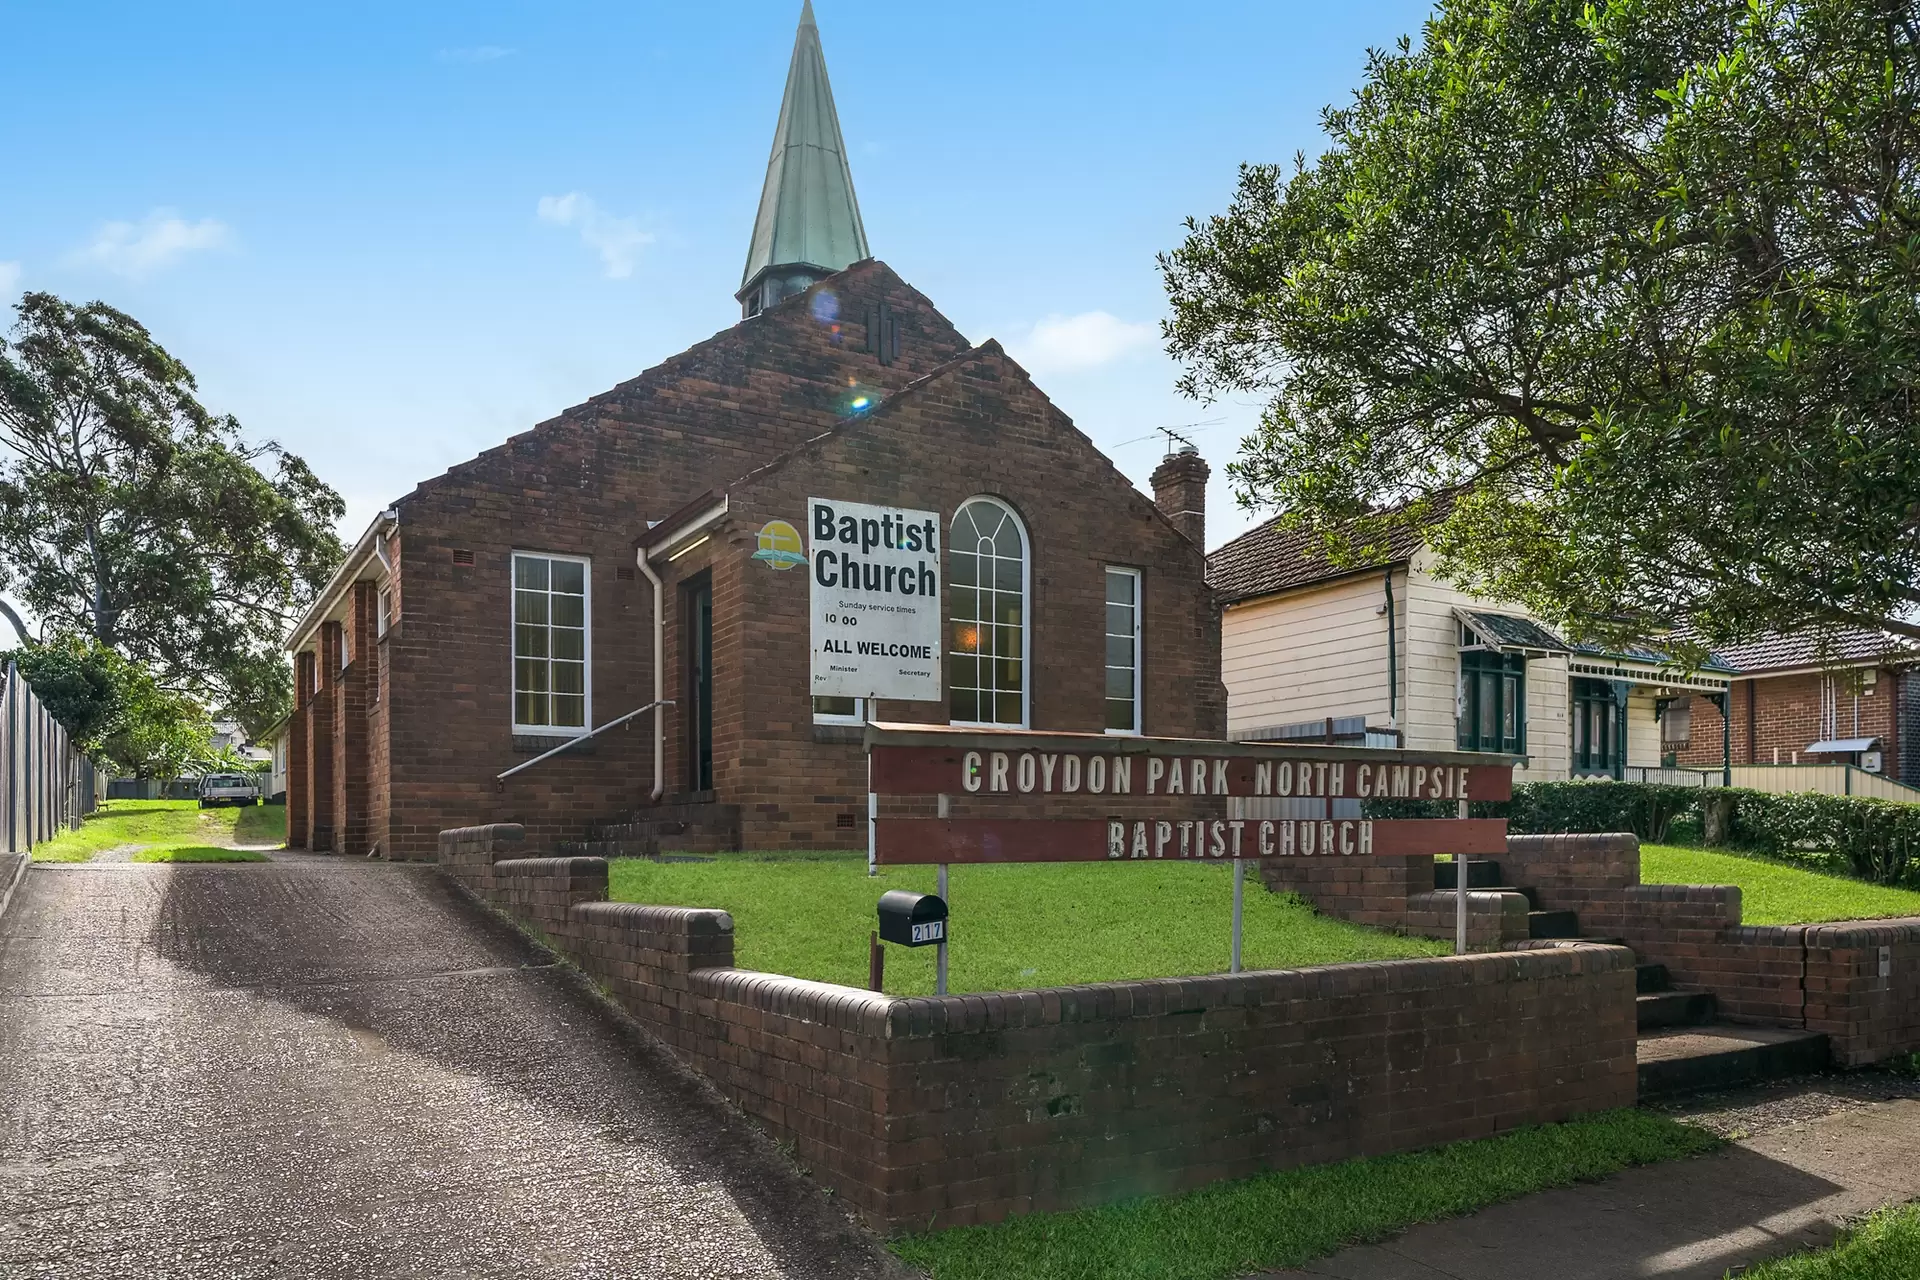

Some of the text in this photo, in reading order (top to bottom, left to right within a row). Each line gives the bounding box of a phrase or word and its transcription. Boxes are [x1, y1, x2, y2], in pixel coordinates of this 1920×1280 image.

[814, 504, 935, 554] Baptist
[815, 550, 936, 597] Church
[839, 600, 917, 615] Sunday service times
[823, 639, 931, 660] ALL WELCOME
[815, 674, 827, 682] Rev
[830, 665, 931, 678] Minister Secretary
[962, 751, 1470, 800] CROYDON PARK NORTH CAMPSIE
[1107, 820, 1374, 858] BAPTIST CHURCH
[914, 922, 942, 941] 217
